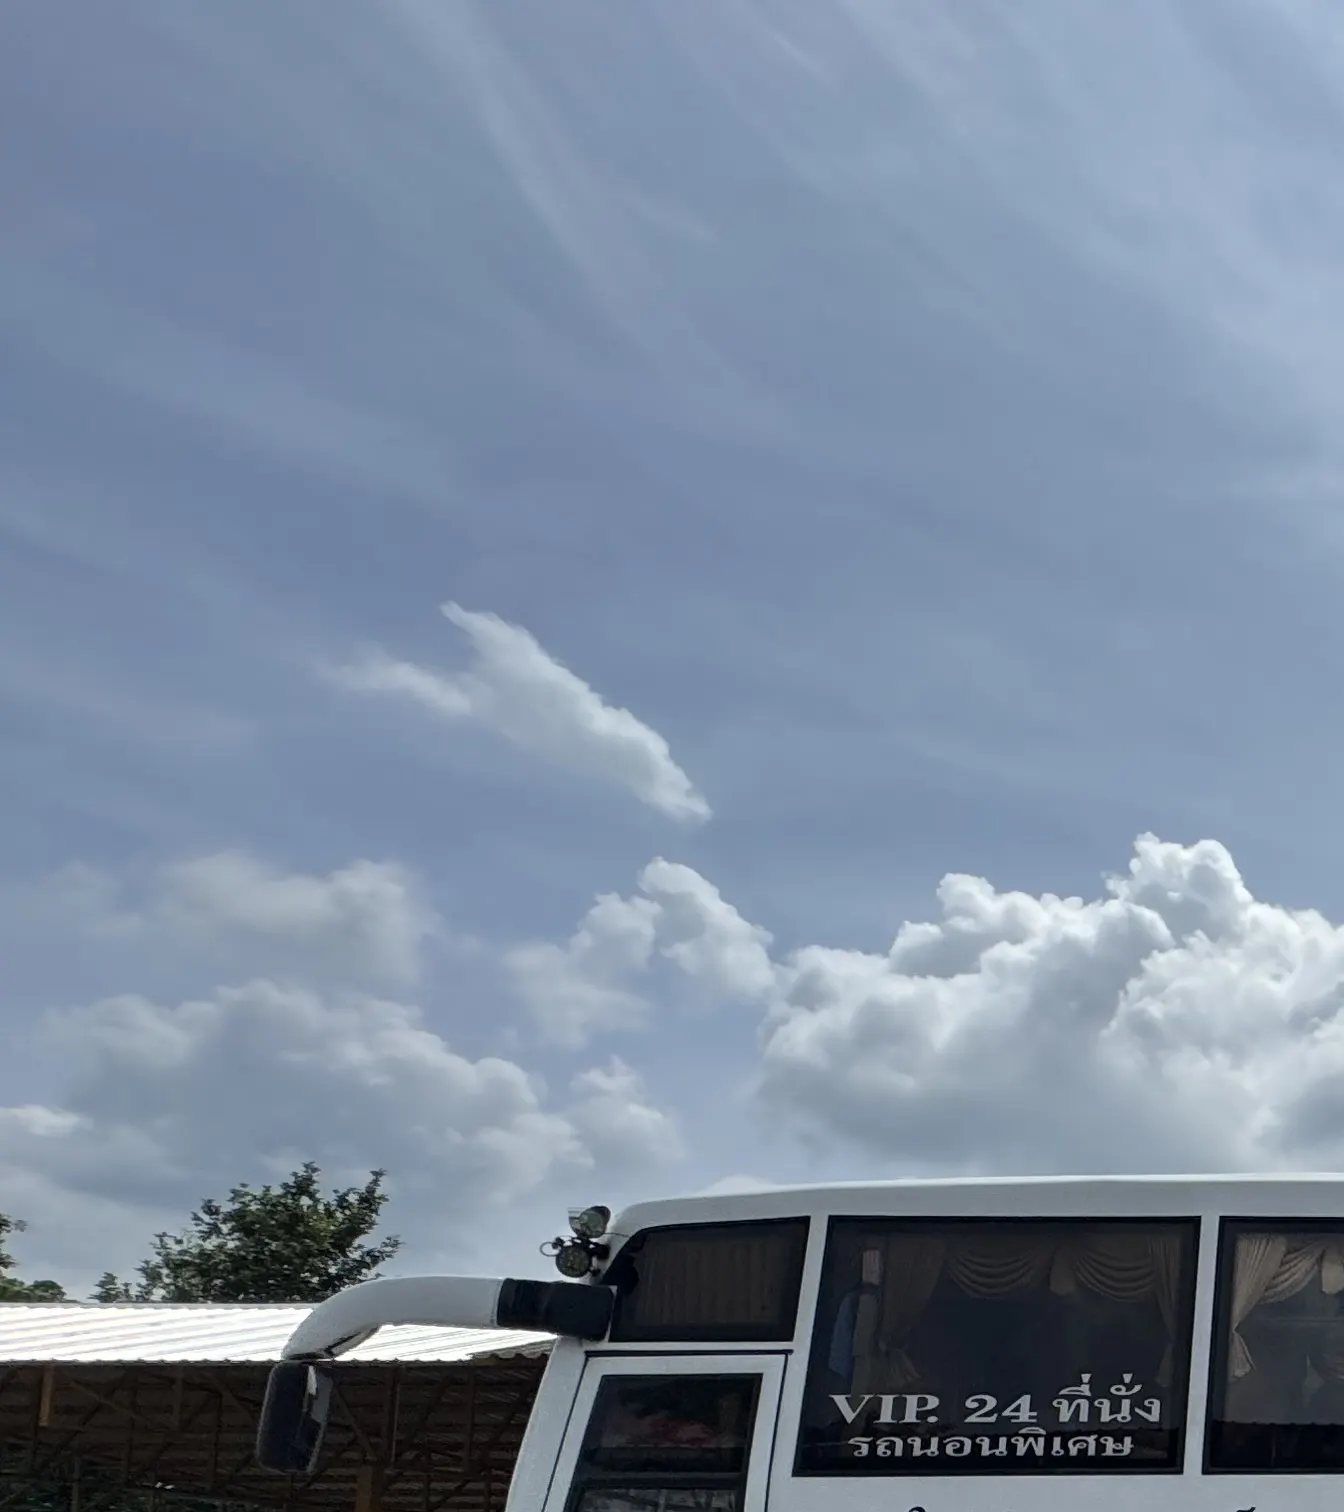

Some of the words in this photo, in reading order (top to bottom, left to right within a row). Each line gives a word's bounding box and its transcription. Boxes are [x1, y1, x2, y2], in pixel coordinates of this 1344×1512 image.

[964, 1394, 1038, 1424] 24
[1052, 1373, 1162, 1423] ที่นั่ง
[847, 1426, 1136, 1457] รถนอนพิเศษ
